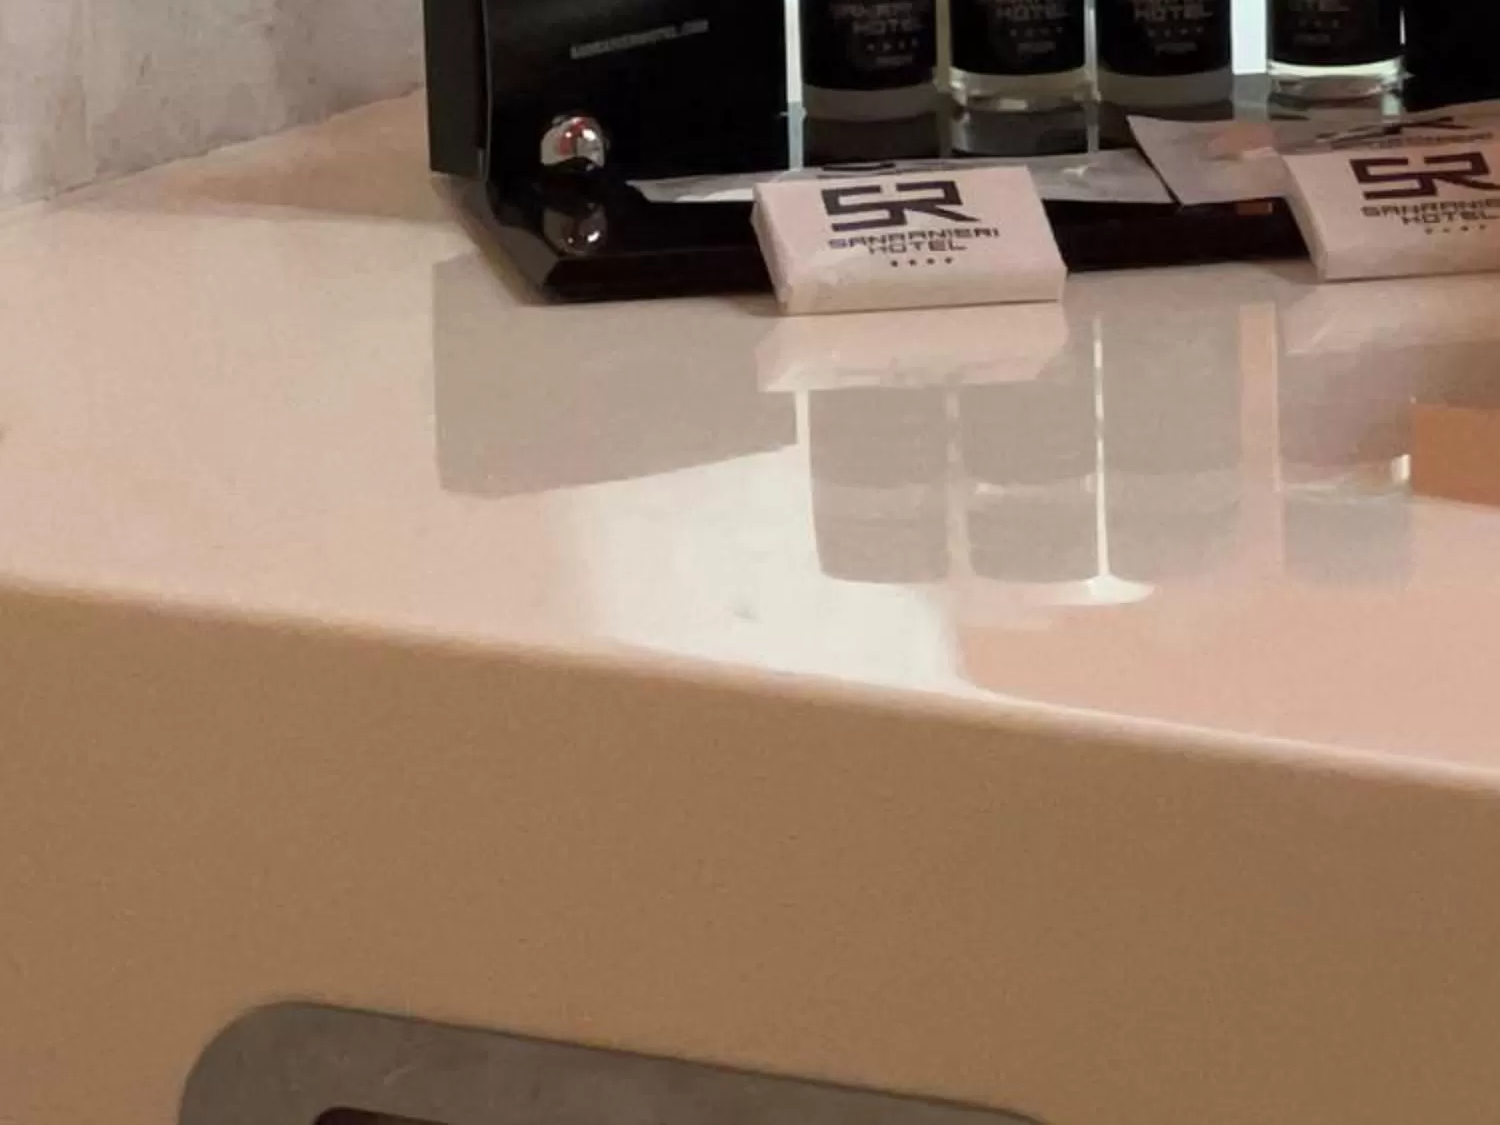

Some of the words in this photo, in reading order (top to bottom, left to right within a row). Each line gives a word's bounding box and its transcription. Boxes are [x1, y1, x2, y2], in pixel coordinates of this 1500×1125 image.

[821, 179, 981, 232] SR
[827, 227, 1000, 249] SANRANIERI
[868, 239, 967, 255] HOTEL
